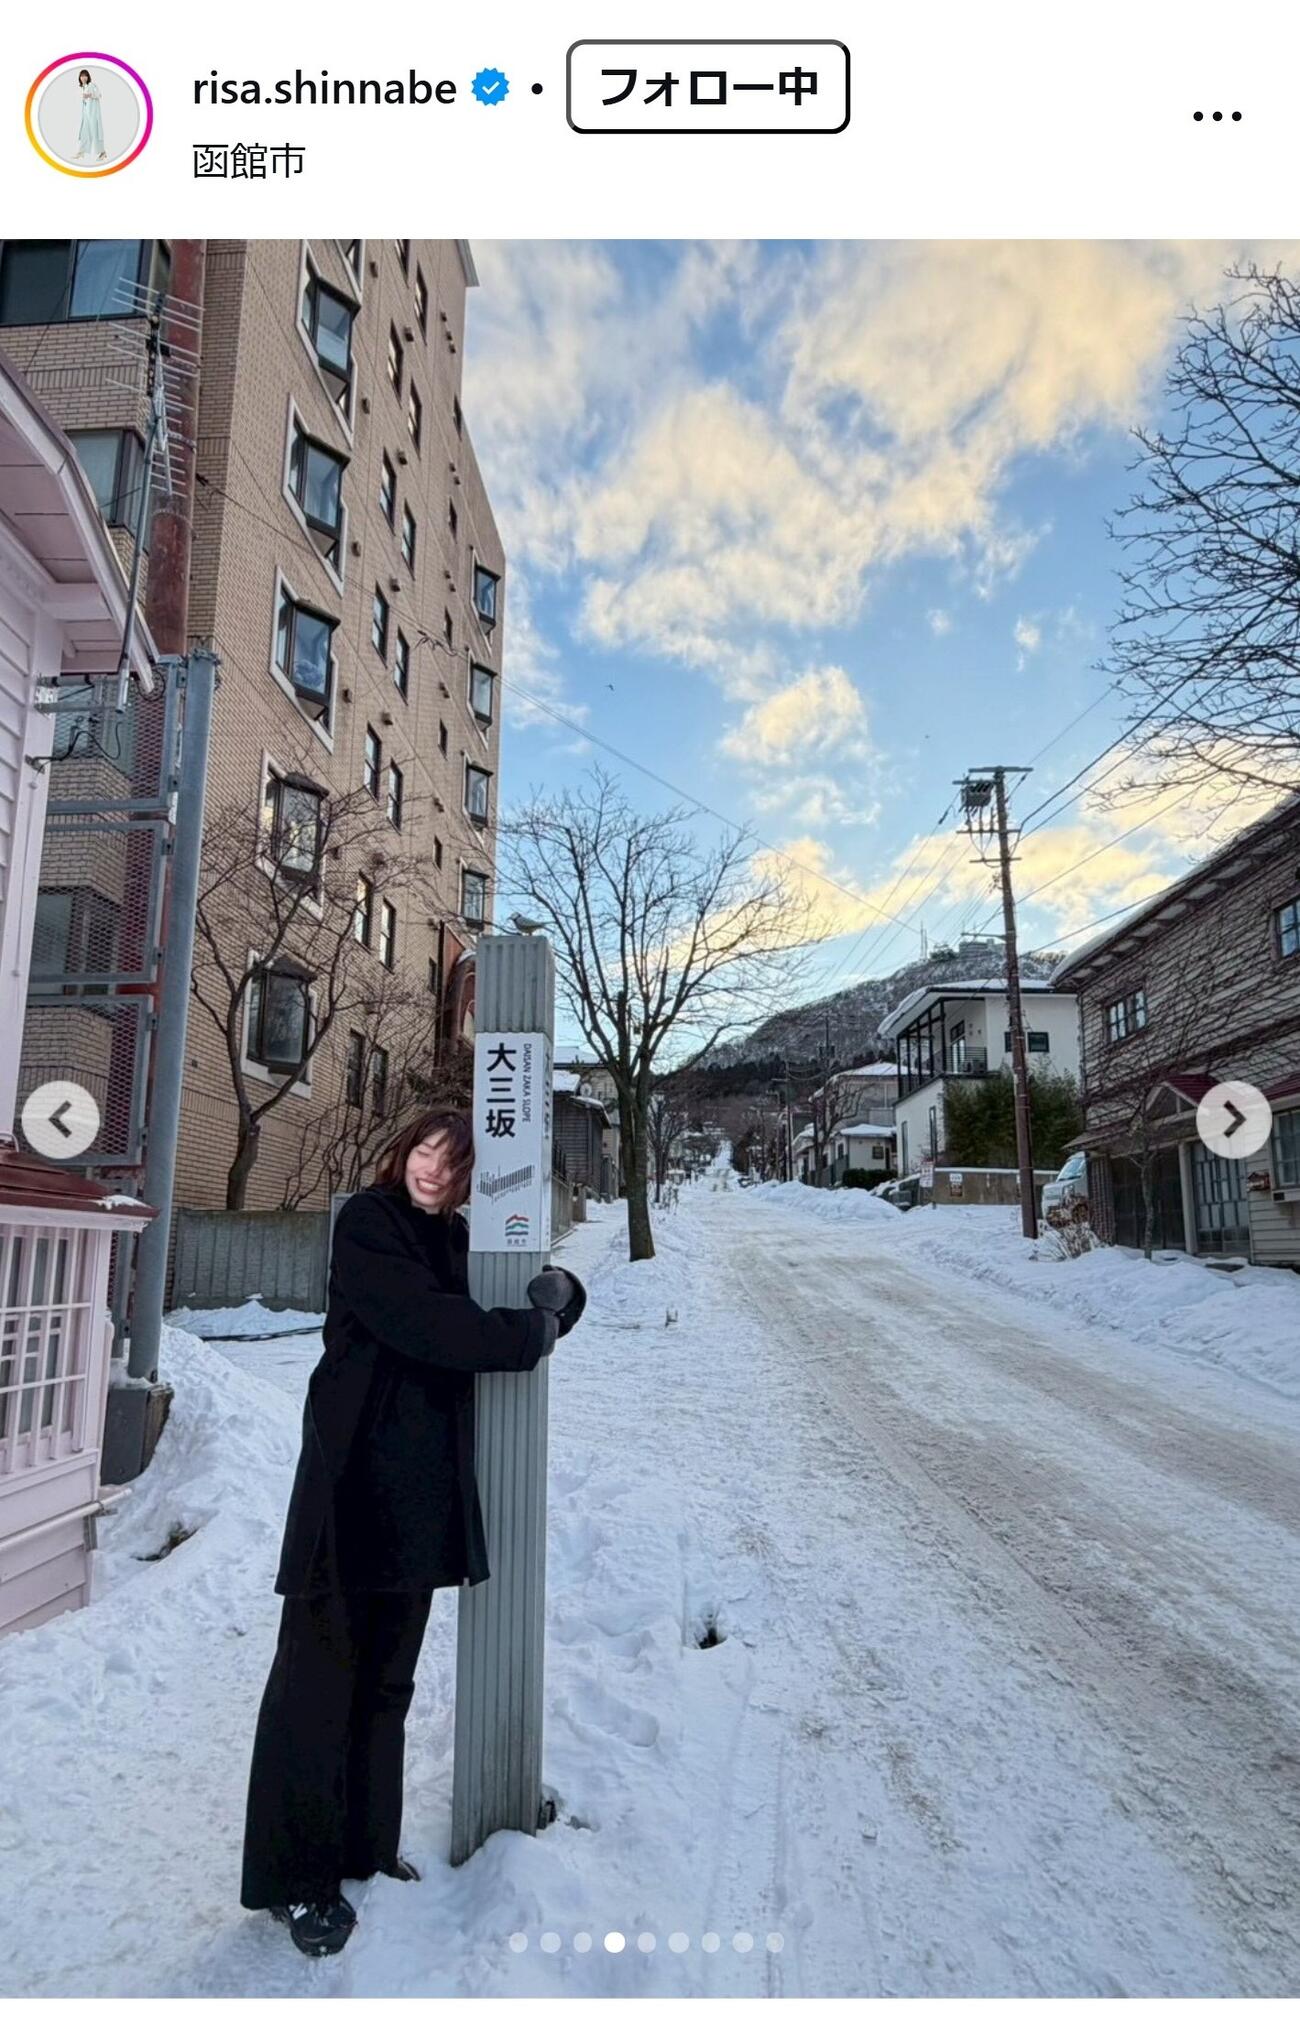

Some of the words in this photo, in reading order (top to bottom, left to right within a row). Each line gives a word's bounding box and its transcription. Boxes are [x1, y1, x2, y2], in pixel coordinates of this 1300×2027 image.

[523, 1043, 533, 1073] DAISAN
[485, 1042, 517, 1139] 大三坂
[522, 1074, 532, 1097] ZAKA
[521, 1098, 532, 1123] SLOPE
